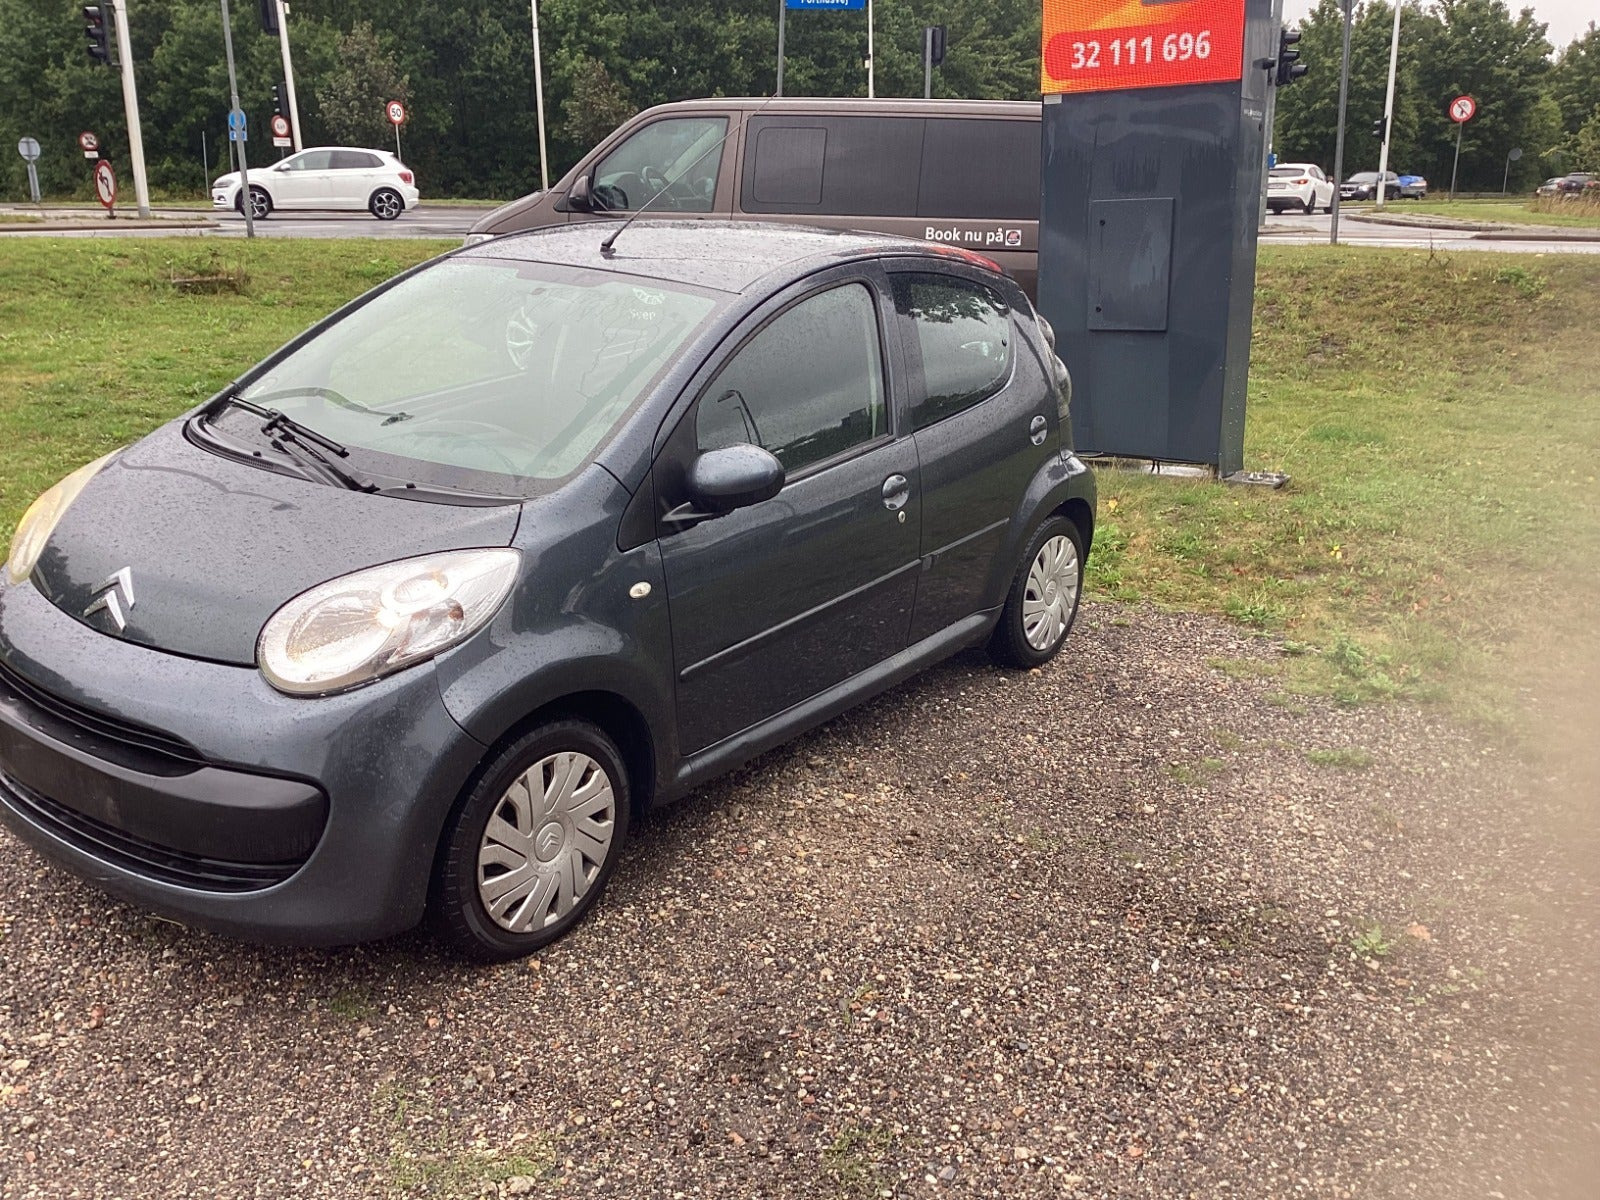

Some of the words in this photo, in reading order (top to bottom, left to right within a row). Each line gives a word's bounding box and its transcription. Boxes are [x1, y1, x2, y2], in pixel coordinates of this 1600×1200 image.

[1071, 40, 1101, 70] 32
[1109, 35, 1153, 66] 111
[1162, 30, 1211, 62] 696
[391, 107, 402, 118] 50
[925, 226, 961, 241] Book
[964, 230, 982, 242] nu
[985, 227, 1004, 246] på
